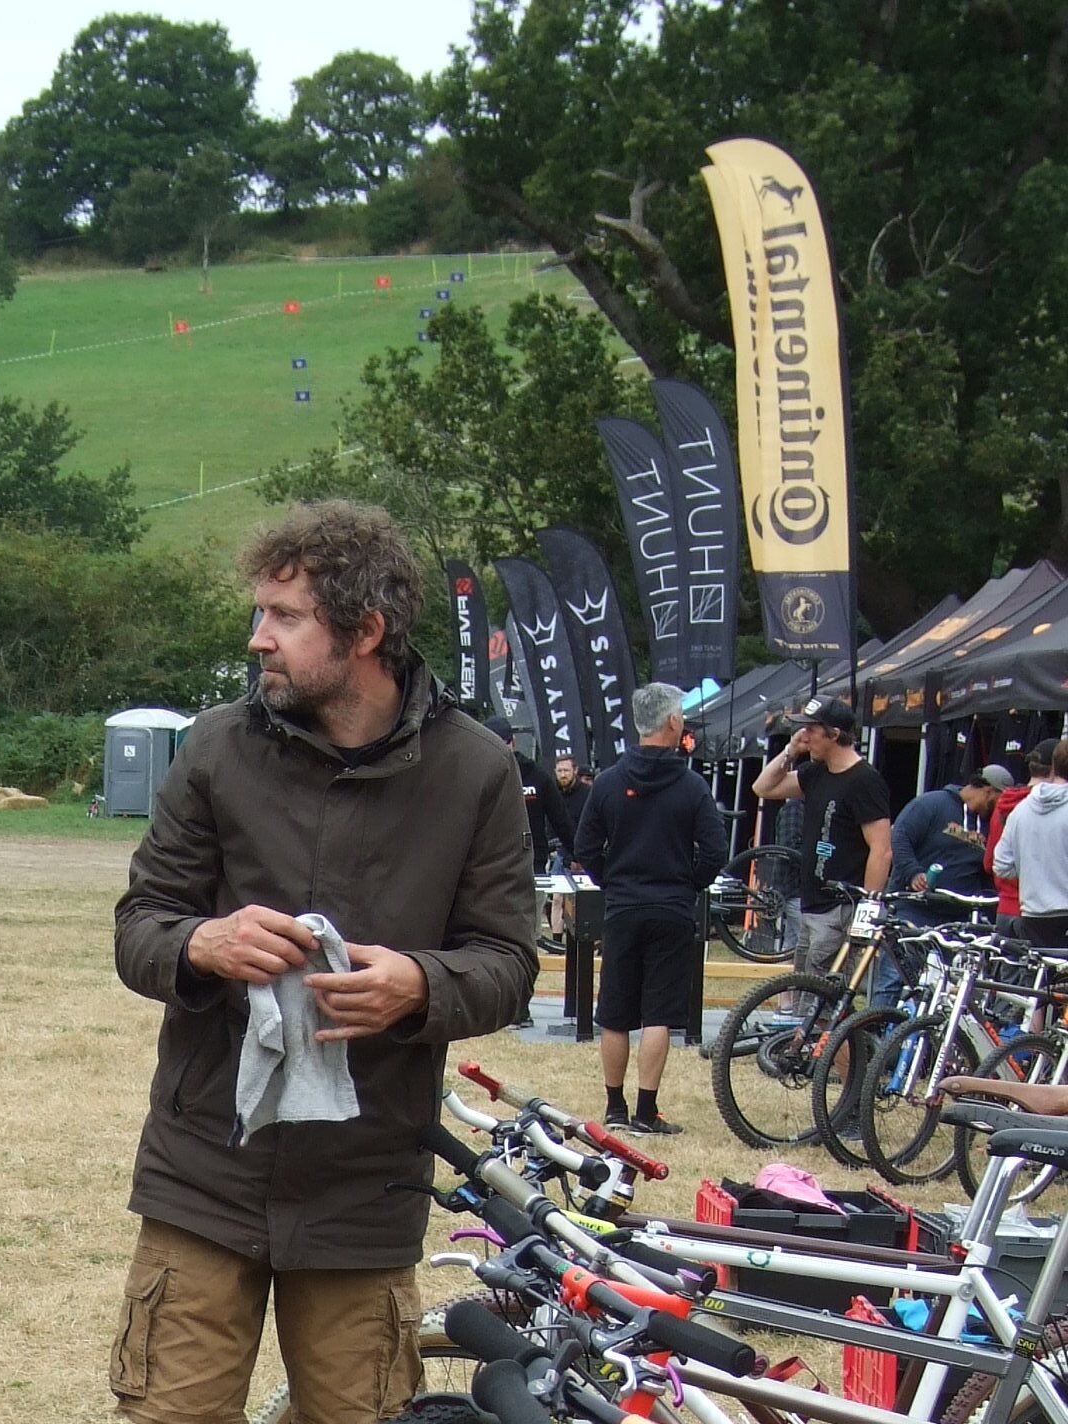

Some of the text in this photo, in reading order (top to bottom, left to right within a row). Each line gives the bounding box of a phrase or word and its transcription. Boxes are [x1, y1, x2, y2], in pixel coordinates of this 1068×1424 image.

[540, 654, 573, 756] EATY'S
[591, 635, 626, 755] EATY'S
[856, 909, 876, 923] 125
